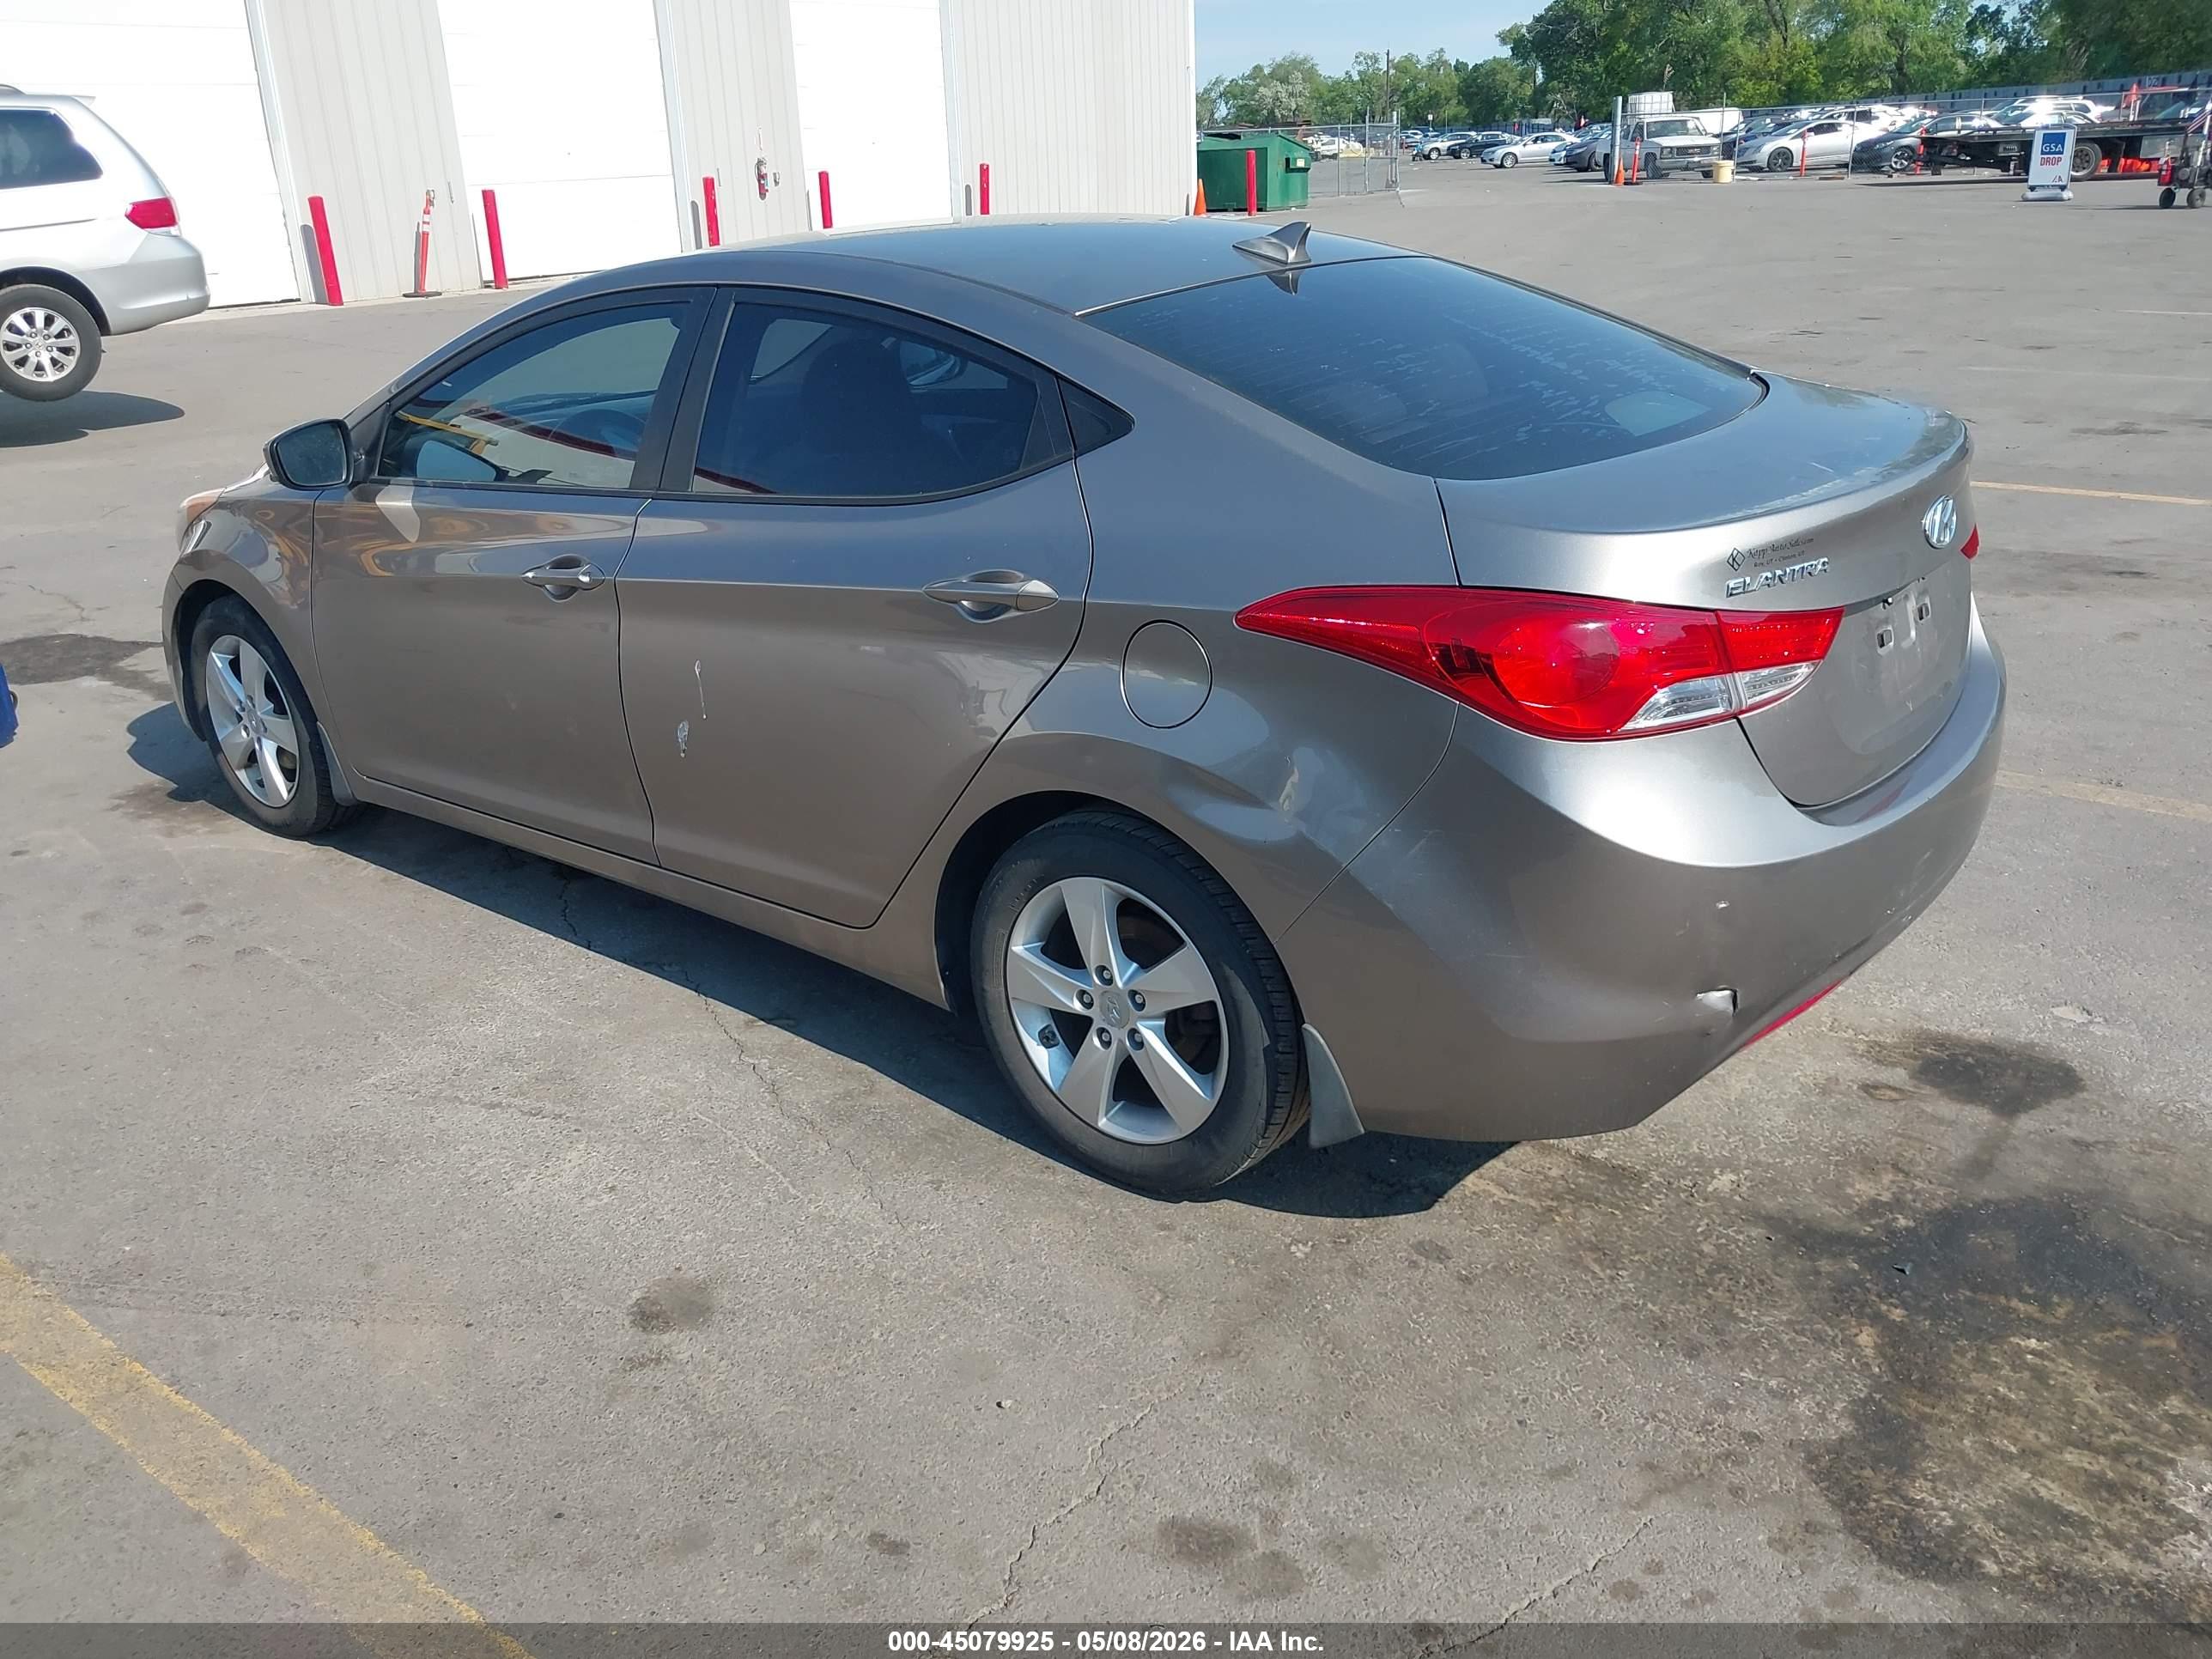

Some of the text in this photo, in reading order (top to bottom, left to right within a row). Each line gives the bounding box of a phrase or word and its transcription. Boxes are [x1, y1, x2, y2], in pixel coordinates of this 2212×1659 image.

[2042, 143, 2063, 152] GSA
[2039, 156, 2063, 167] DROP
[1726, 556, 1830, 599] ELANTRA
